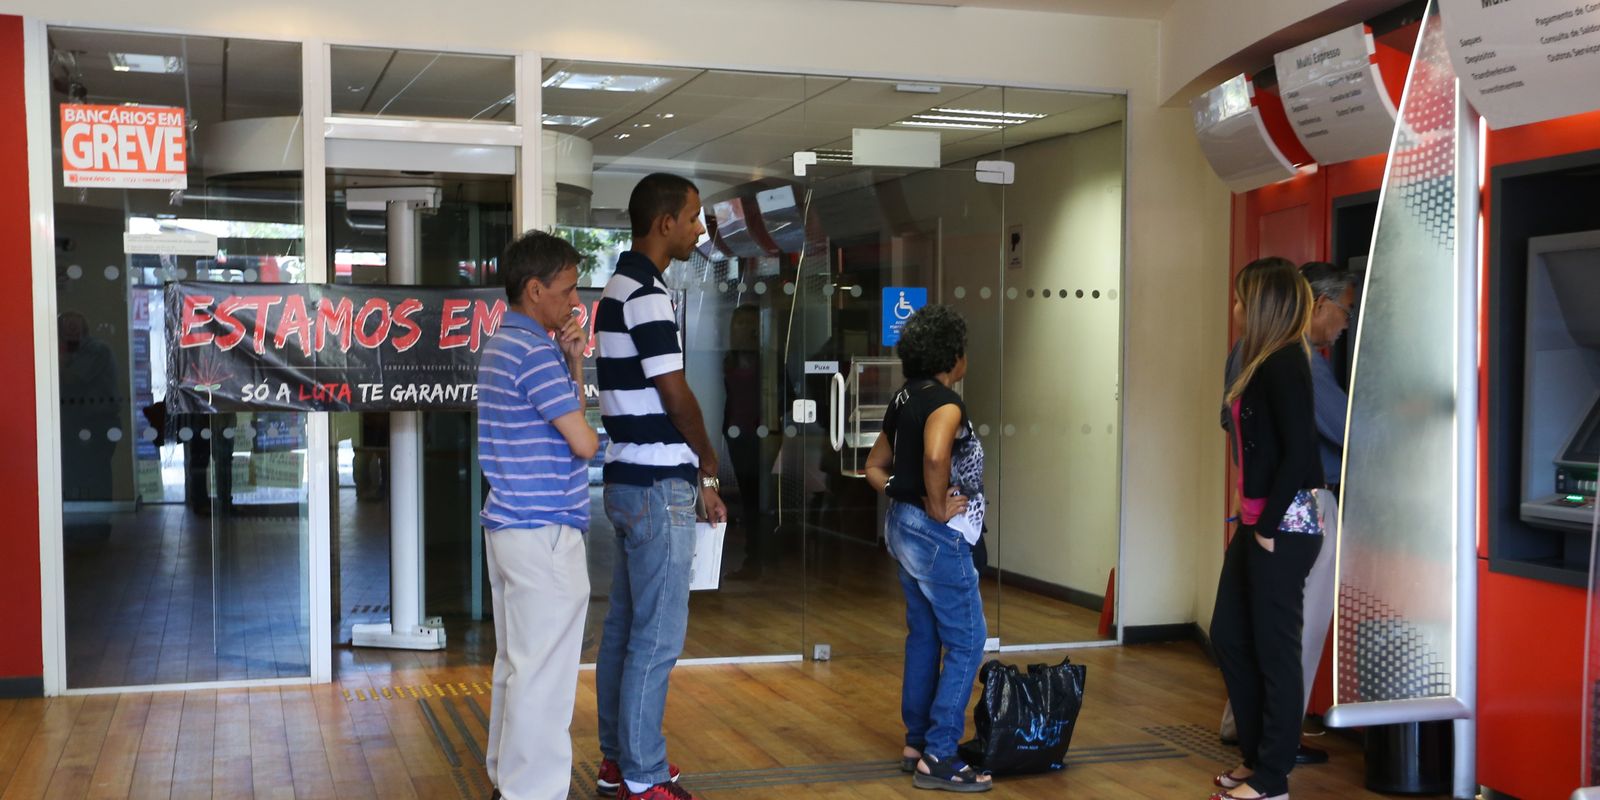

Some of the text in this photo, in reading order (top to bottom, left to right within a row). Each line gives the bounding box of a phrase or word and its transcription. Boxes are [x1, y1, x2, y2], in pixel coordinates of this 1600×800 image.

[1534, 10, 1573, 27] Pagamento
[1574, 7, 1584, 16] de
[1459, 36, 1482, 48] Saques
[1540, 32, 1570, 45] Consulta
[1570, 29, 1579, 38] de
[1296, 48, 1341, 69] Multi Expresso
[1547, 51, 1572, 62] Outros
[64, 108, 182, 126] BANCÁRIOS EM
[63, 122, 185, 172] GREVE
[180, 294, 424, 358] ESTAMOS
[439, 298, 508, 353] EM
[241, 378, 479, 404] SÓ A LUTA TE GARANTE
